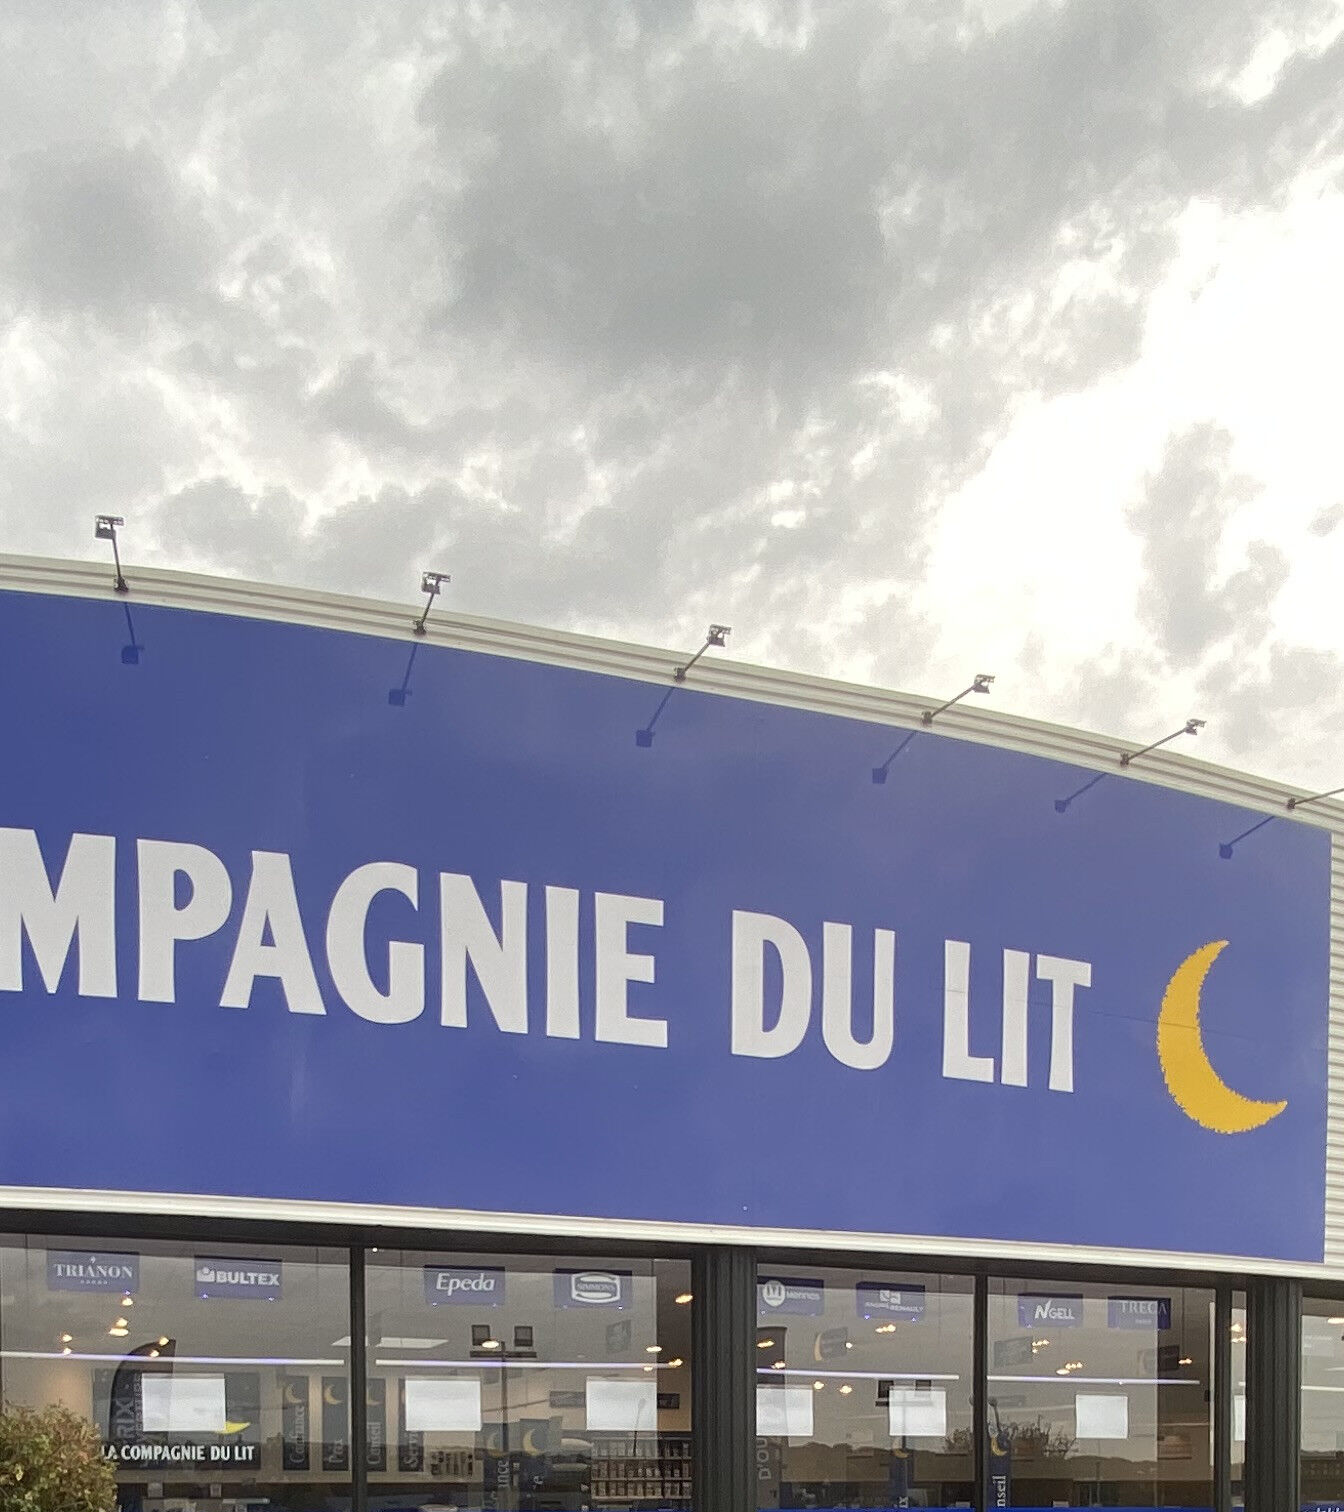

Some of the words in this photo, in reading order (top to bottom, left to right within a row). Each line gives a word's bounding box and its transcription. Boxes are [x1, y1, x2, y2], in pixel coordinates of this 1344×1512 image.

[731, 909, 896, 1071] DU
[942, 939, 1092, 1093] LIT
[216, 1272, 281, 1287] BULTEX
[435, 1272, 496, 1297] Epeda
[1119, 1300, 1168, 1315] TRECA
[121, 1445, 206, 1461] COMPAGNIE
[210, 1446, 230, 1461] DU
[234, 1446, 255, 1461] LIT
[992, 1475, 1006, 1507] nseil
